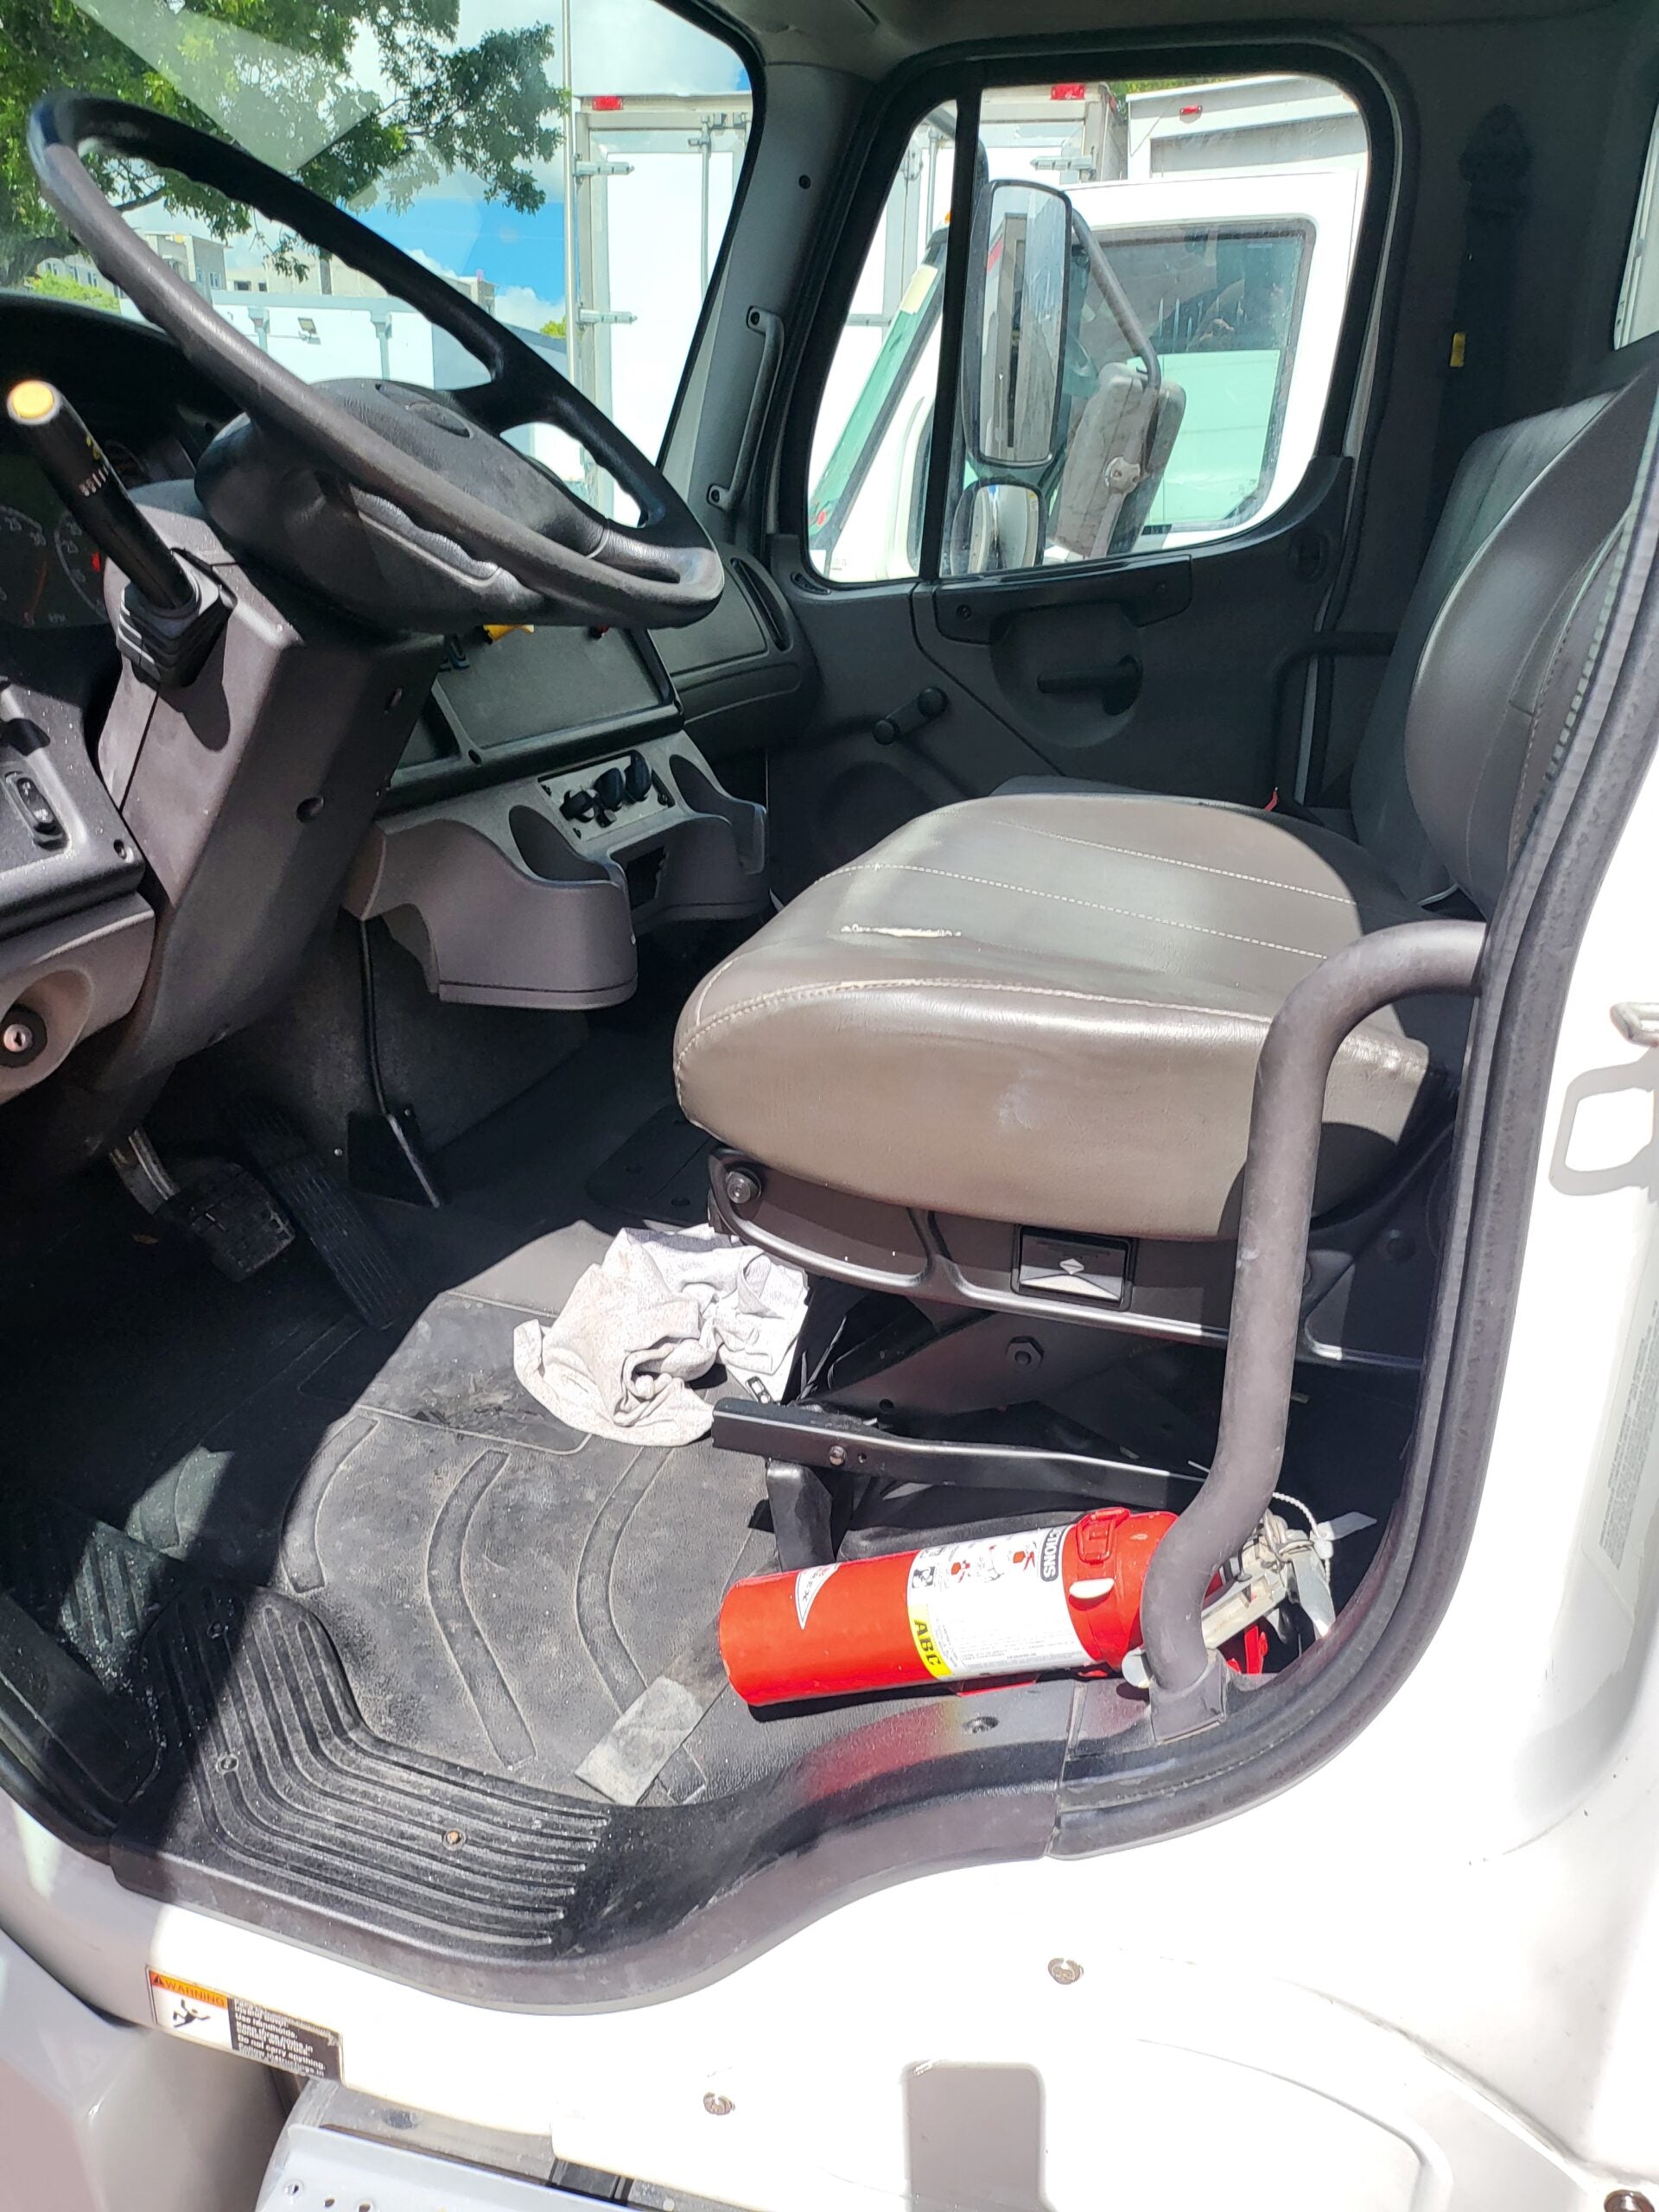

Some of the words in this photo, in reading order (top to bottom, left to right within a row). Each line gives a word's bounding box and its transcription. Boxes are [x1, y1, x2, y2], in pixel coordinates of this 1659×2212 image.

[913, 1619, 942, 1666] ABC
[164, 1980, 226, 2008] WARNING
[238, 2033, 250, 2044] Do
[251, 2039, 264, 2050] not
[265, 2044, 287, 2058] carry
[288, 2052, 326, 2071] anything.
